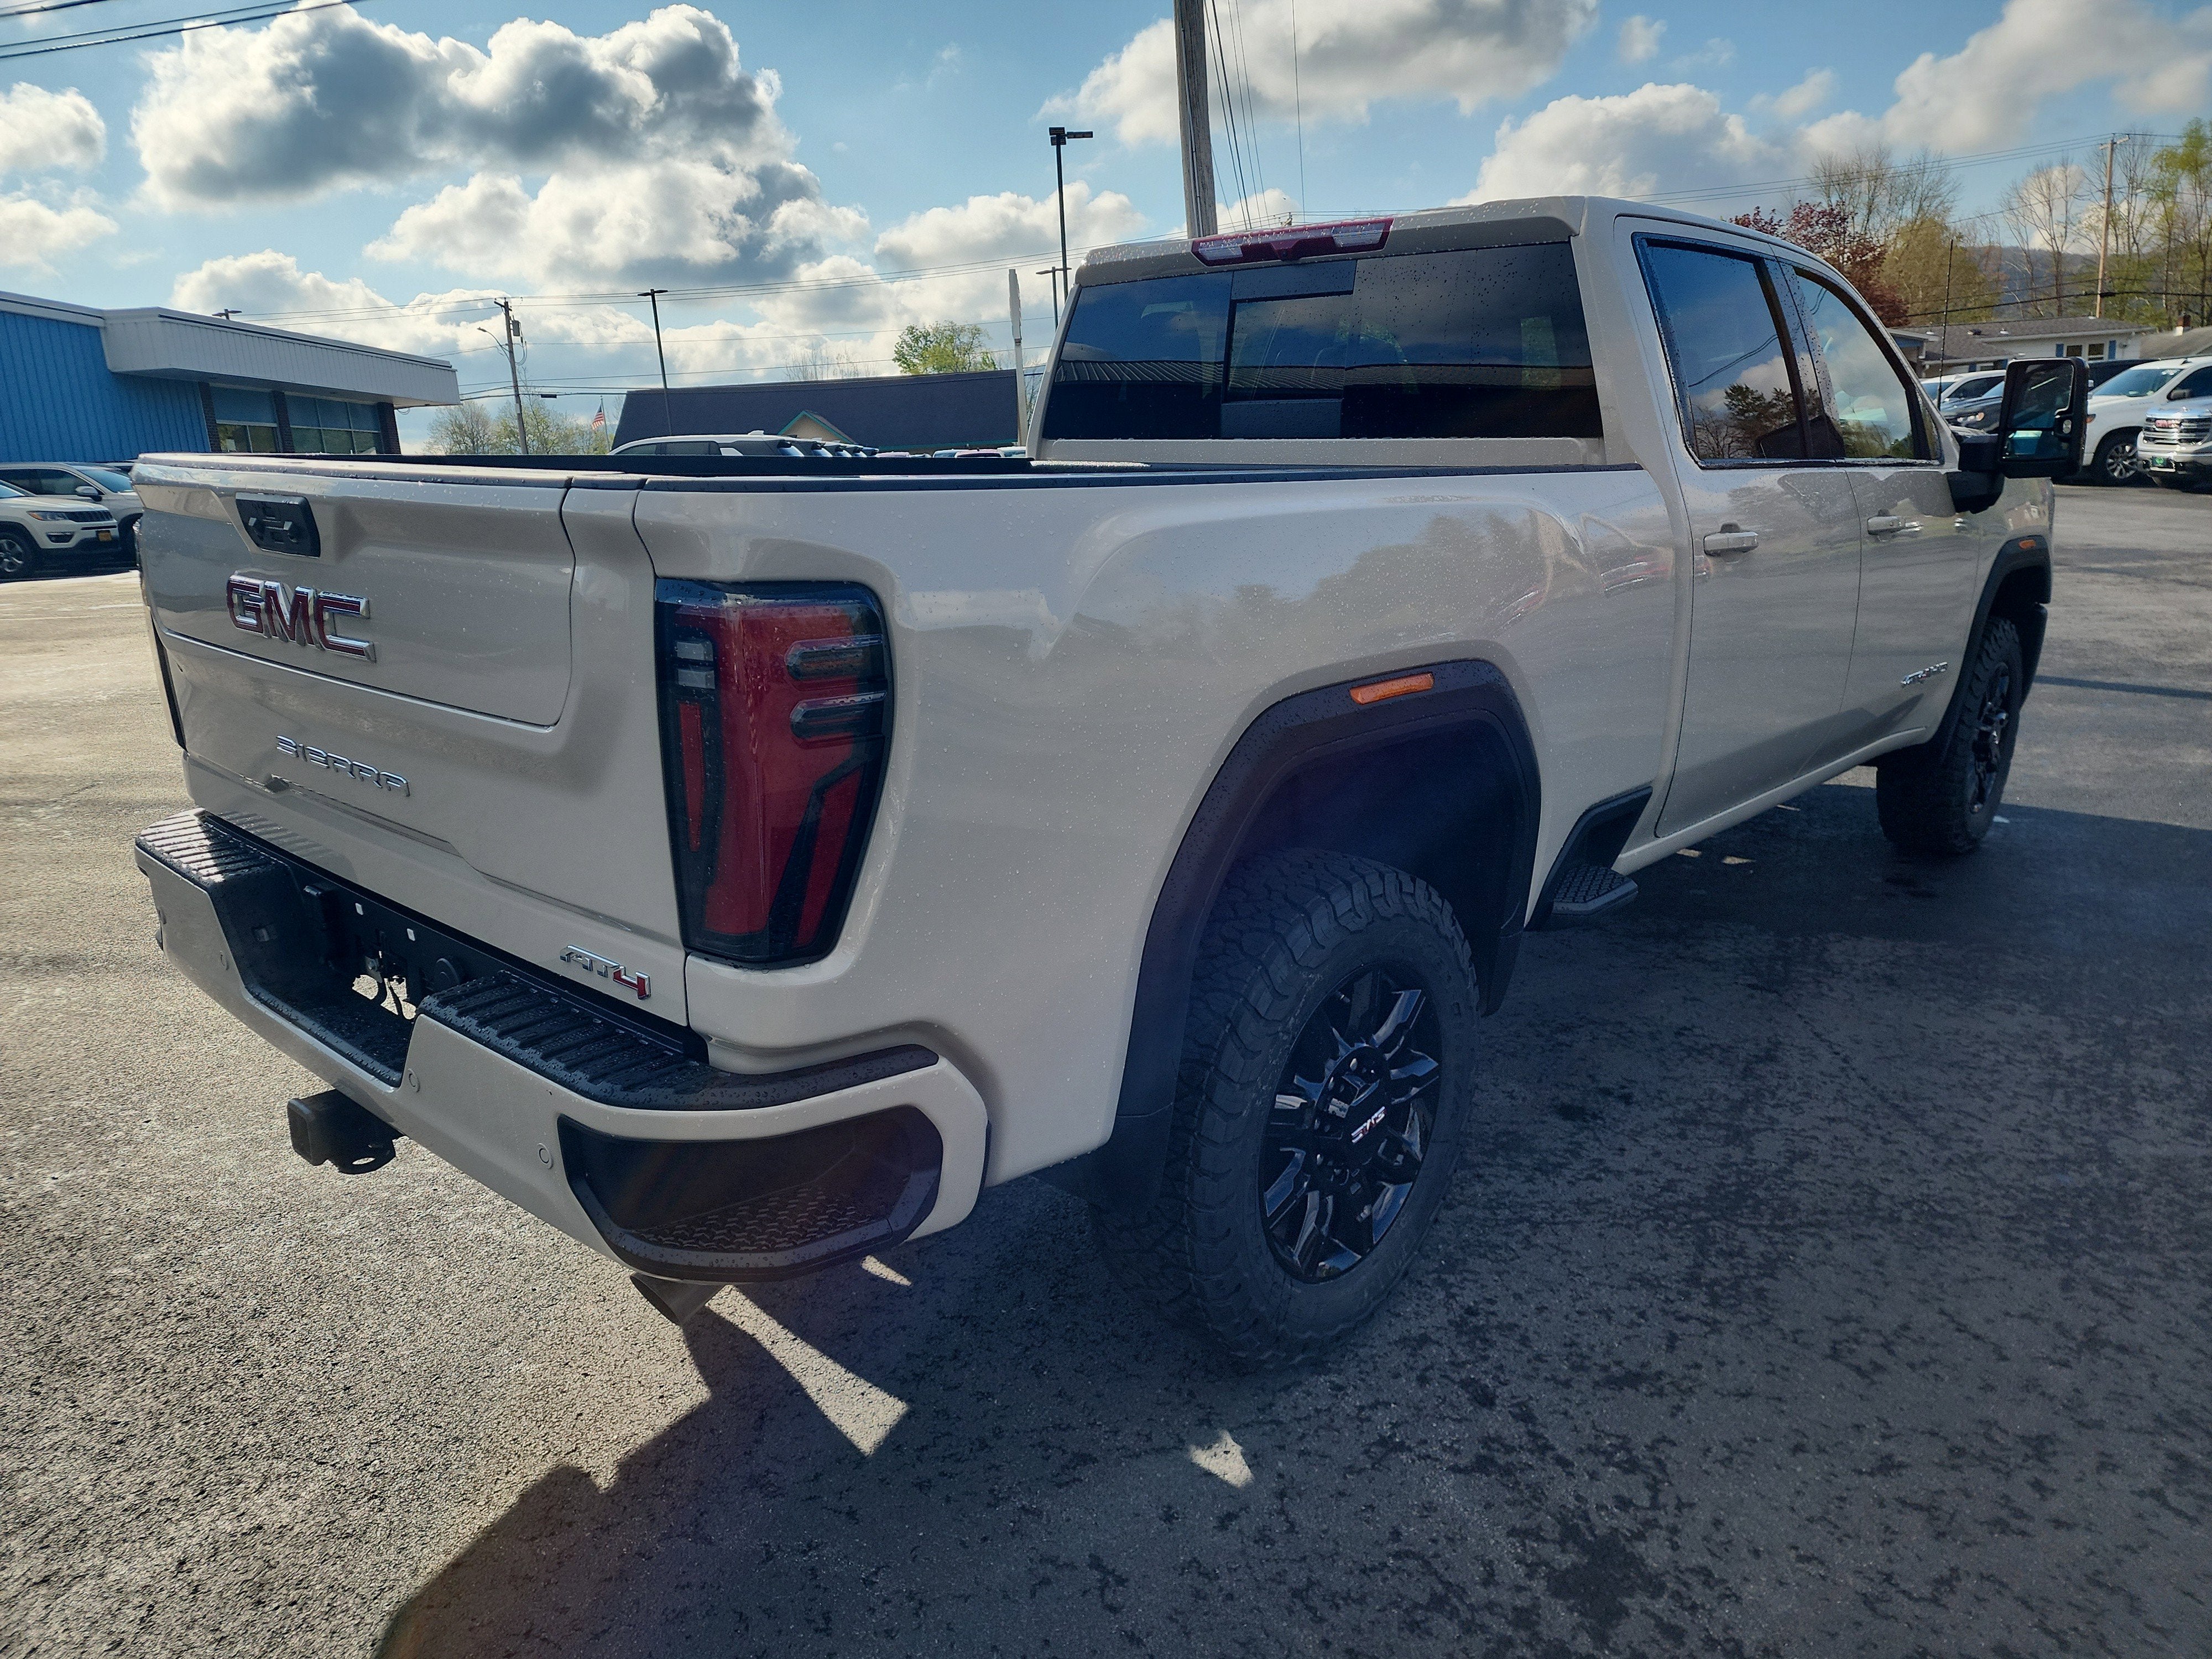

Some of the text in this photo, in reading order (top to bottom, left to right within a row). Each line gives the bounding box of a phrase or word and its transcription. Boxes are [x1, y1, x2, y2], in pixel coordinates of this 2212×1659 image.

[226, 572, 377, 664] GMC
[276, 735, 410, 796] SIERRA
[560, 945, 651, 999] AT4
